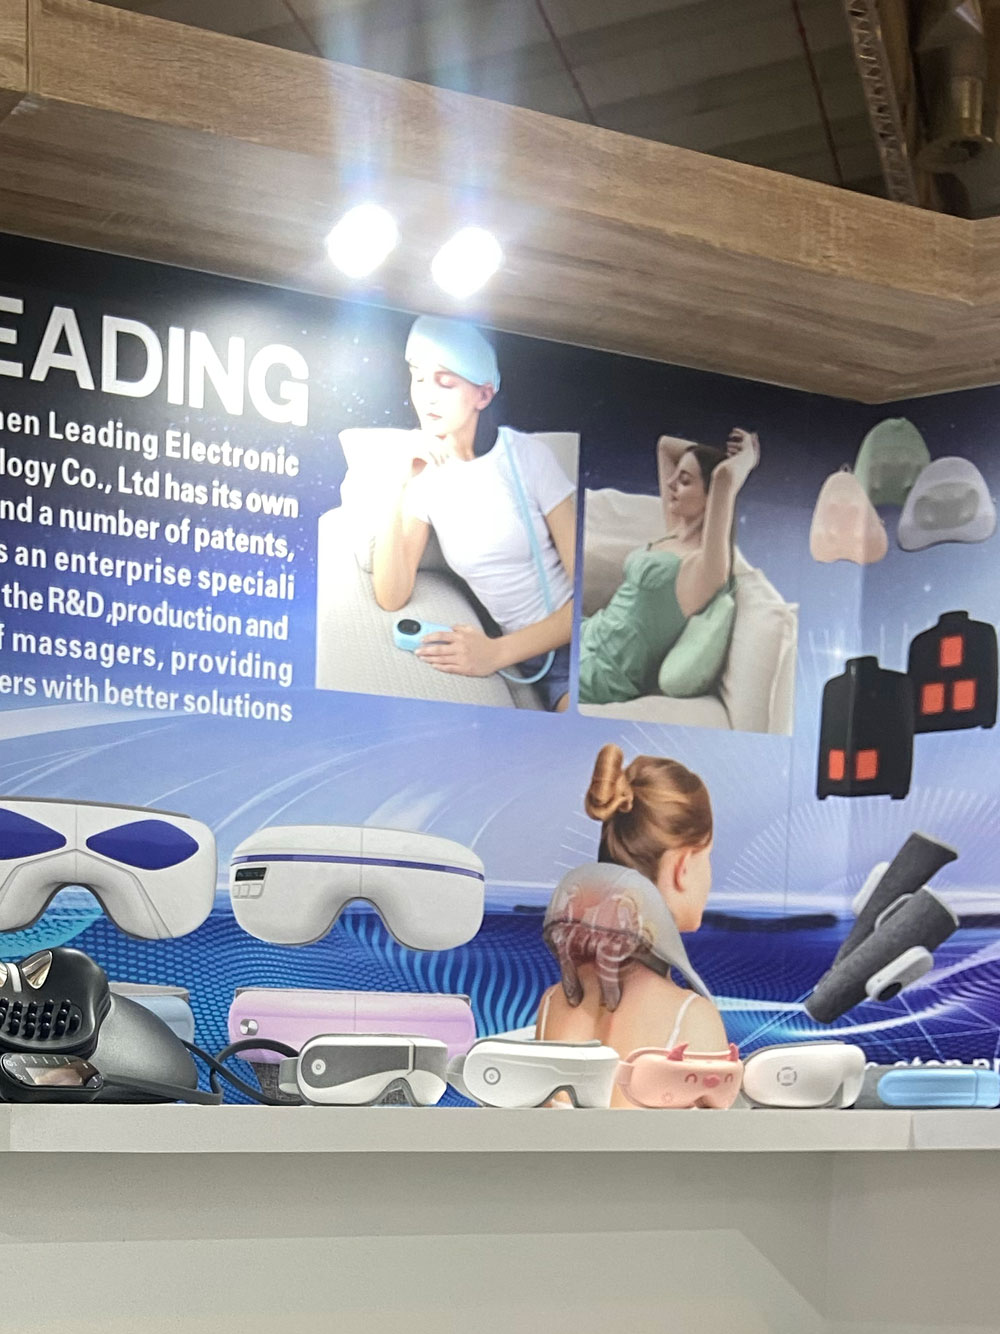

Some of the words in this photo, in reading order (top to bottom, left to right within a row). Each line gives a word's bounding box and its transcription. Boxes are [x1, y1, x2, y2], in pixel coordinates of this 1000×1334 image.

[49, 411, 158, 460] Leading
[165, 431, 299, 477] Electronic
[62, 458, 112, 494] Co.,
[118, 466, 160, 497] Ltd
[165, 473, 208, 505] has
[212, 481, 242, 511] its
[247, 491, 299, 518] own
[39, 506, 53, 526] a
[60, 509, 160, 542] number
[165, 519, 190, 545] of
[195, 528, 295, 562] patents,
[15, 545, 47, 568] an
[54, 551, 191, 588] enterprise
[198, 567, 294, 600] speciali
[1, 584, 43, 611] the
[246, 614, 289, 640] and
[12, 632, 164, 670] massagers,
[171, 649, 292, 686] providing
[42, 674, 98, 703] with
[104, 679, 178, 711] better
[184, 688, 292, 722] solutions
